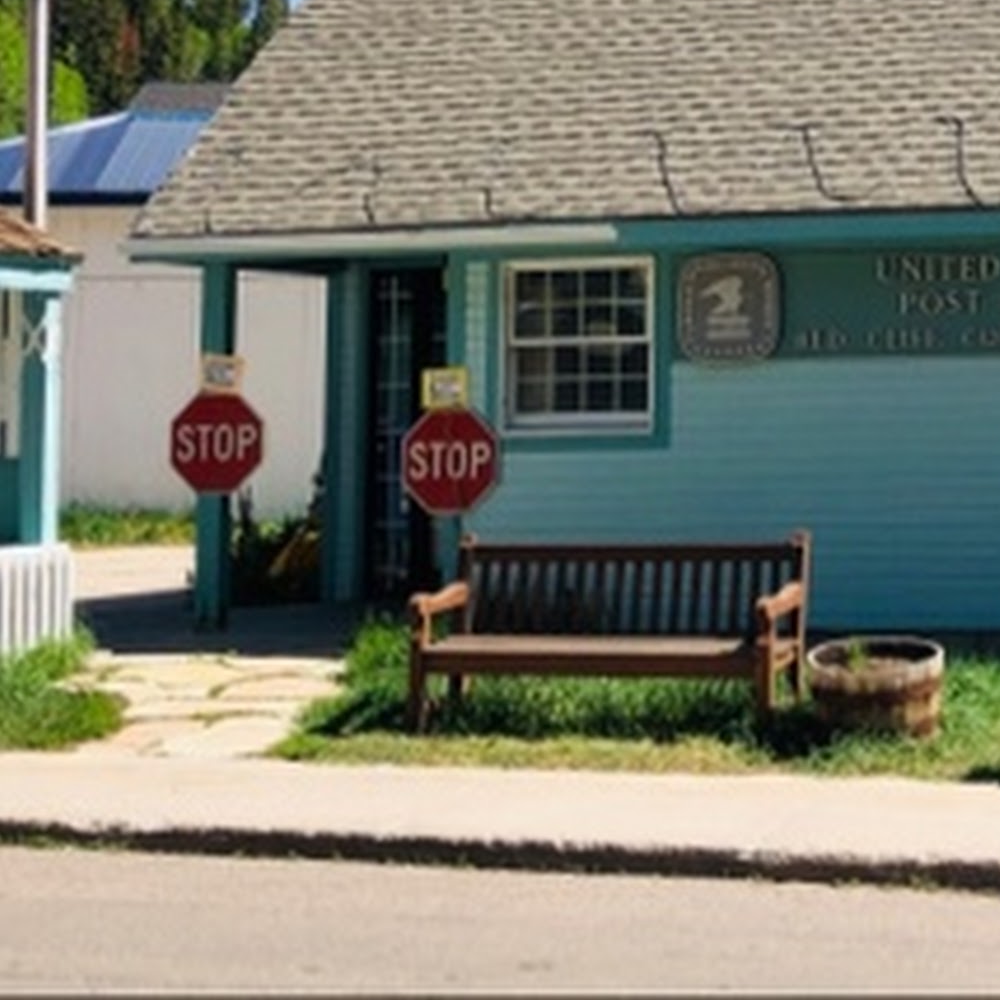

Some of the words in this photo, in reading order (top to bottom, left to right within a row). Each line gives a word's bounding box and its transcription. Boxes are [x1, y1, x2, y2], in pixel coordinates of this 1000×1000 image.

[875, 255, 1000, 283] UNITED
[899, 288, 982, 315] POST
[175, 423, 258, 463] STOP
[408, 439, 491, 480] STOP
